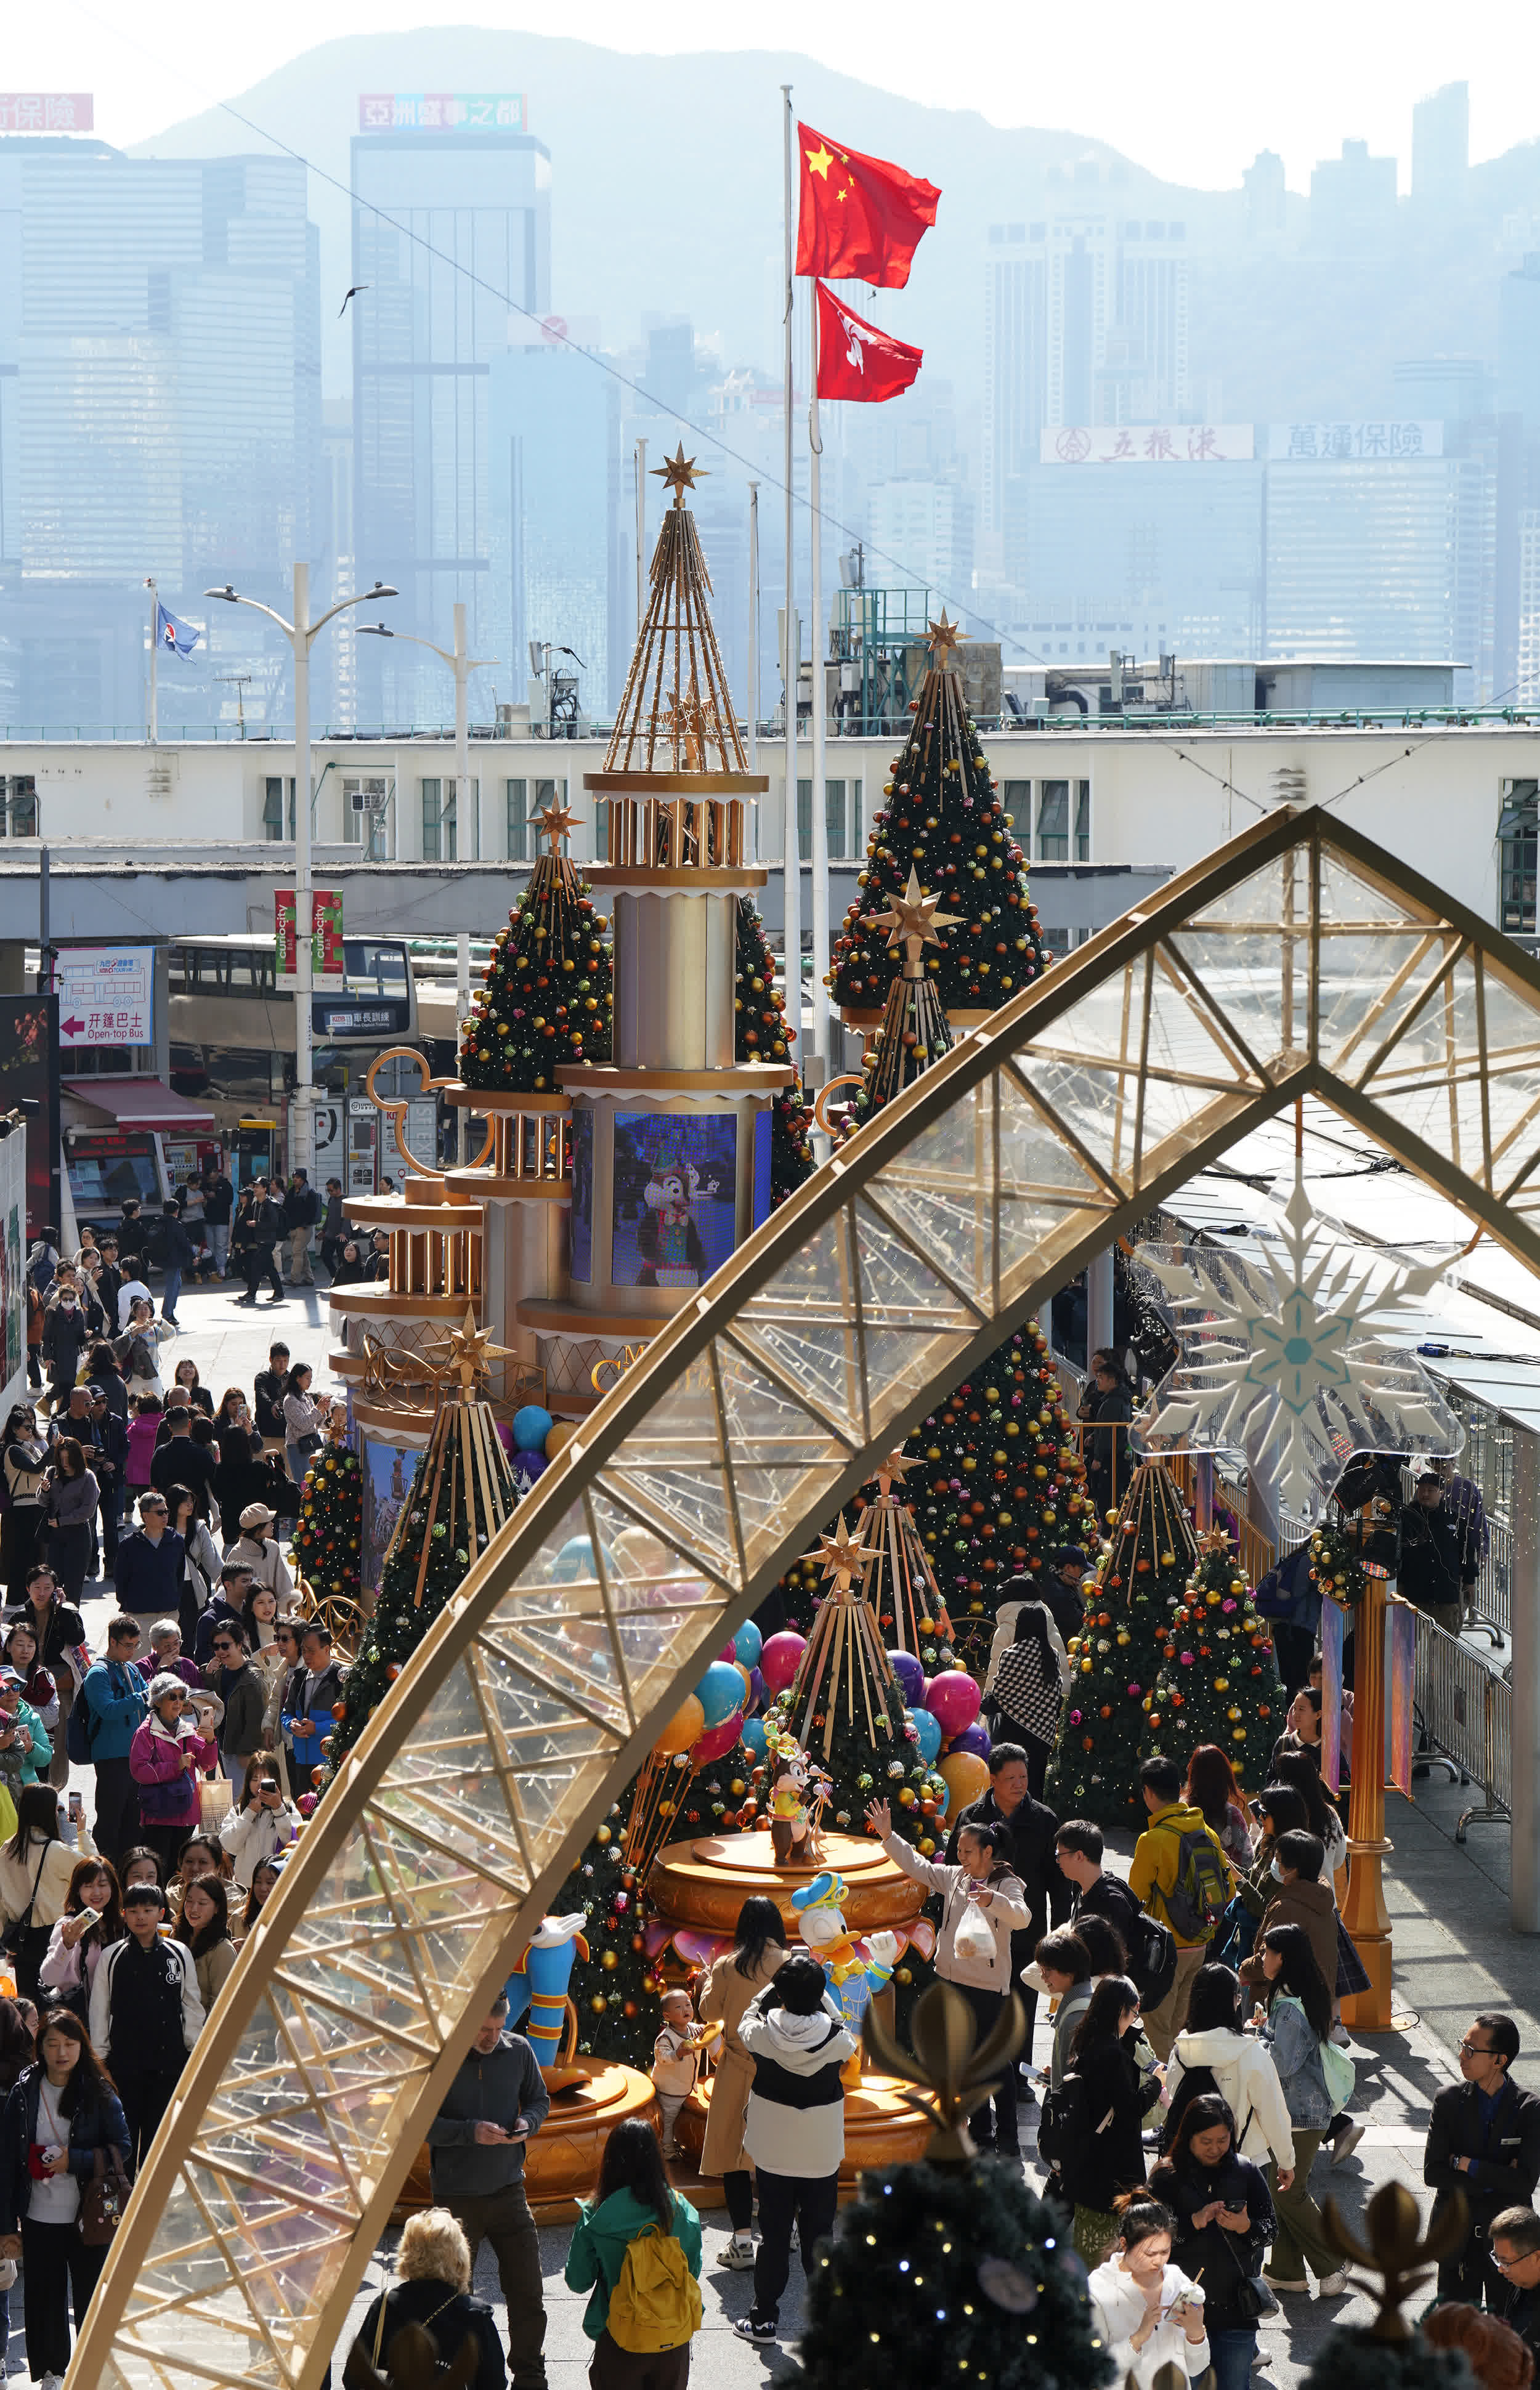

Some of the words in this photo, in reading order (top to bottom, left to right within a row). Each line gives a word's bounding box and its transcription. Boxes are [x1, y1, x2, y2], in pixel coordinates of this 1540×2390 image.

[1287, 423, 1425, 458] 萬通保險
[89, 1011, 142, 1029] 开篷巴士
[354, 1012, 389, 1023] 車長訓練
[87, 1029, 127, 1040] Open-top
[129, 1028, 144, 1038] Bus
